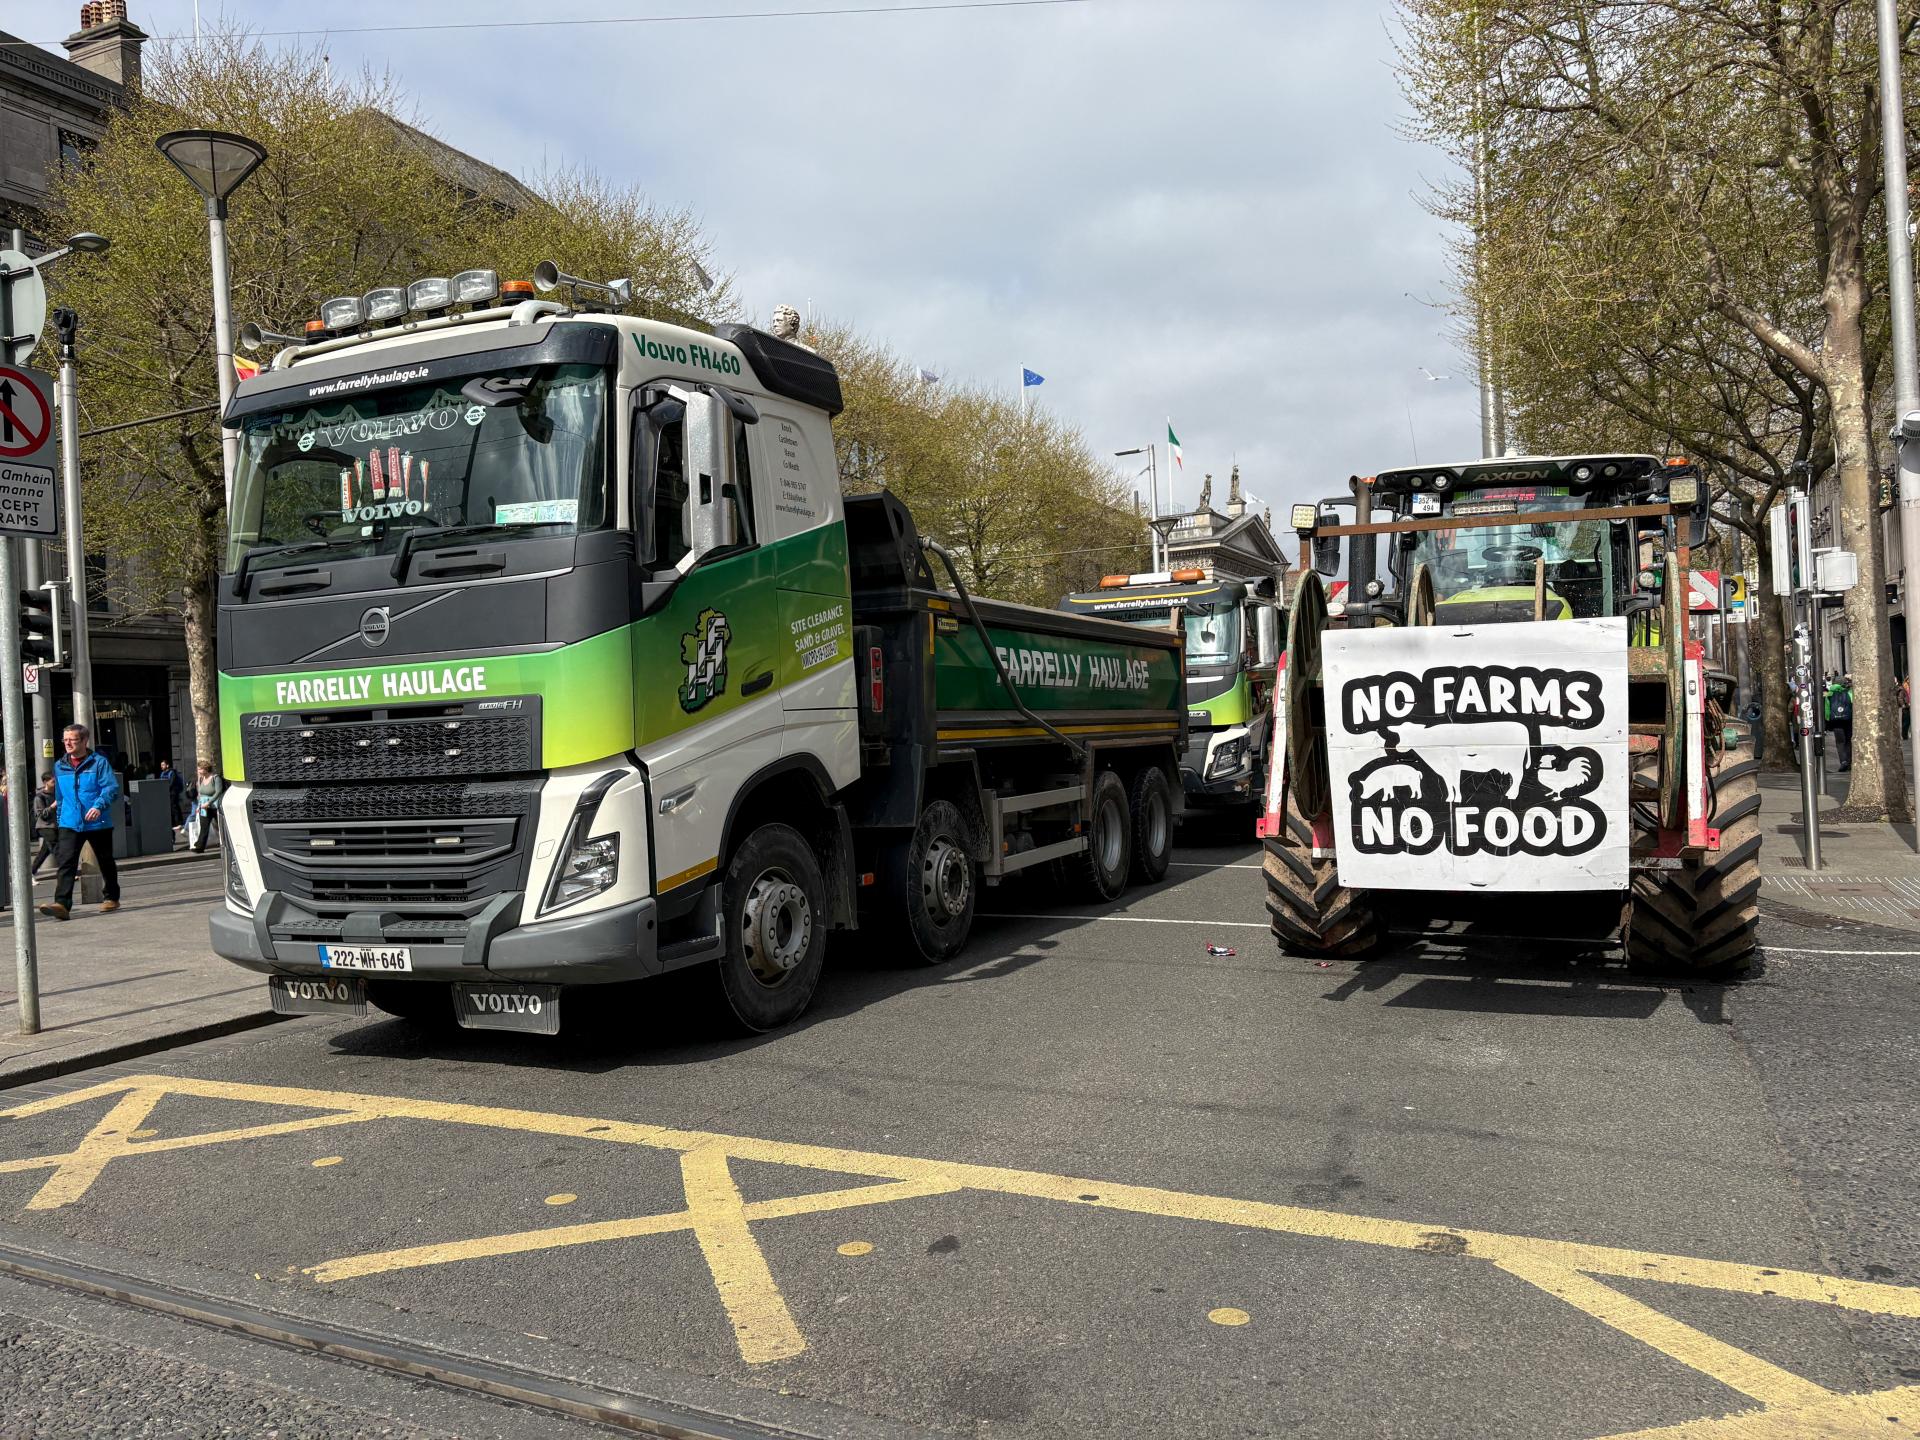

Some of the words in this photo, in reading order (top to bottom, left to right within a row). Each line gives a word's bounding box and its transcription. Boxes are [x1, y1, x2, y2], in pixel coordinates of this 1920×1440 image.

[689, 344, 741, 375] FH460
[308, 366, 430, 397] www.farrellyhaulage.ie
[322, 407, 459, 447] VOLVO
[1472, 469, 1549, 483] AXION
[342, 500, 422, 523] VOLVO
[1422, 504, 1434, 513] 494
[1094, 597, 1188, 611] www.farrellyhaulage.ie
[791, 619, 807, 635] SITE
[807, 605, 844, 628] CLEARANCE
[795, 634, 814, 652] SAND
[815, 632, 820, 644] &
[821, 623, 845, 641] GRAVEL
[996, 647, 1081, 687] FARRELLY
[1088, 655, 1149, 689] HAULAGE
[276, 674, 371, 704] FARRELLY
[382, 667, 486, 697] HAULAGE
[1352, 681, 1415, 724] NO
[1434, 675, 1593, 720] FARMS
[247, 714, 281, 728] 460
[1361, 806, 1433, 847] NO
[1456, 805, 1595, 847] FOOD
[334, 950, 405, 969] 222-MH-646
[284, 981, 349, 1000] VOLVO
[470, 993, 542, 1014] VOLVO
